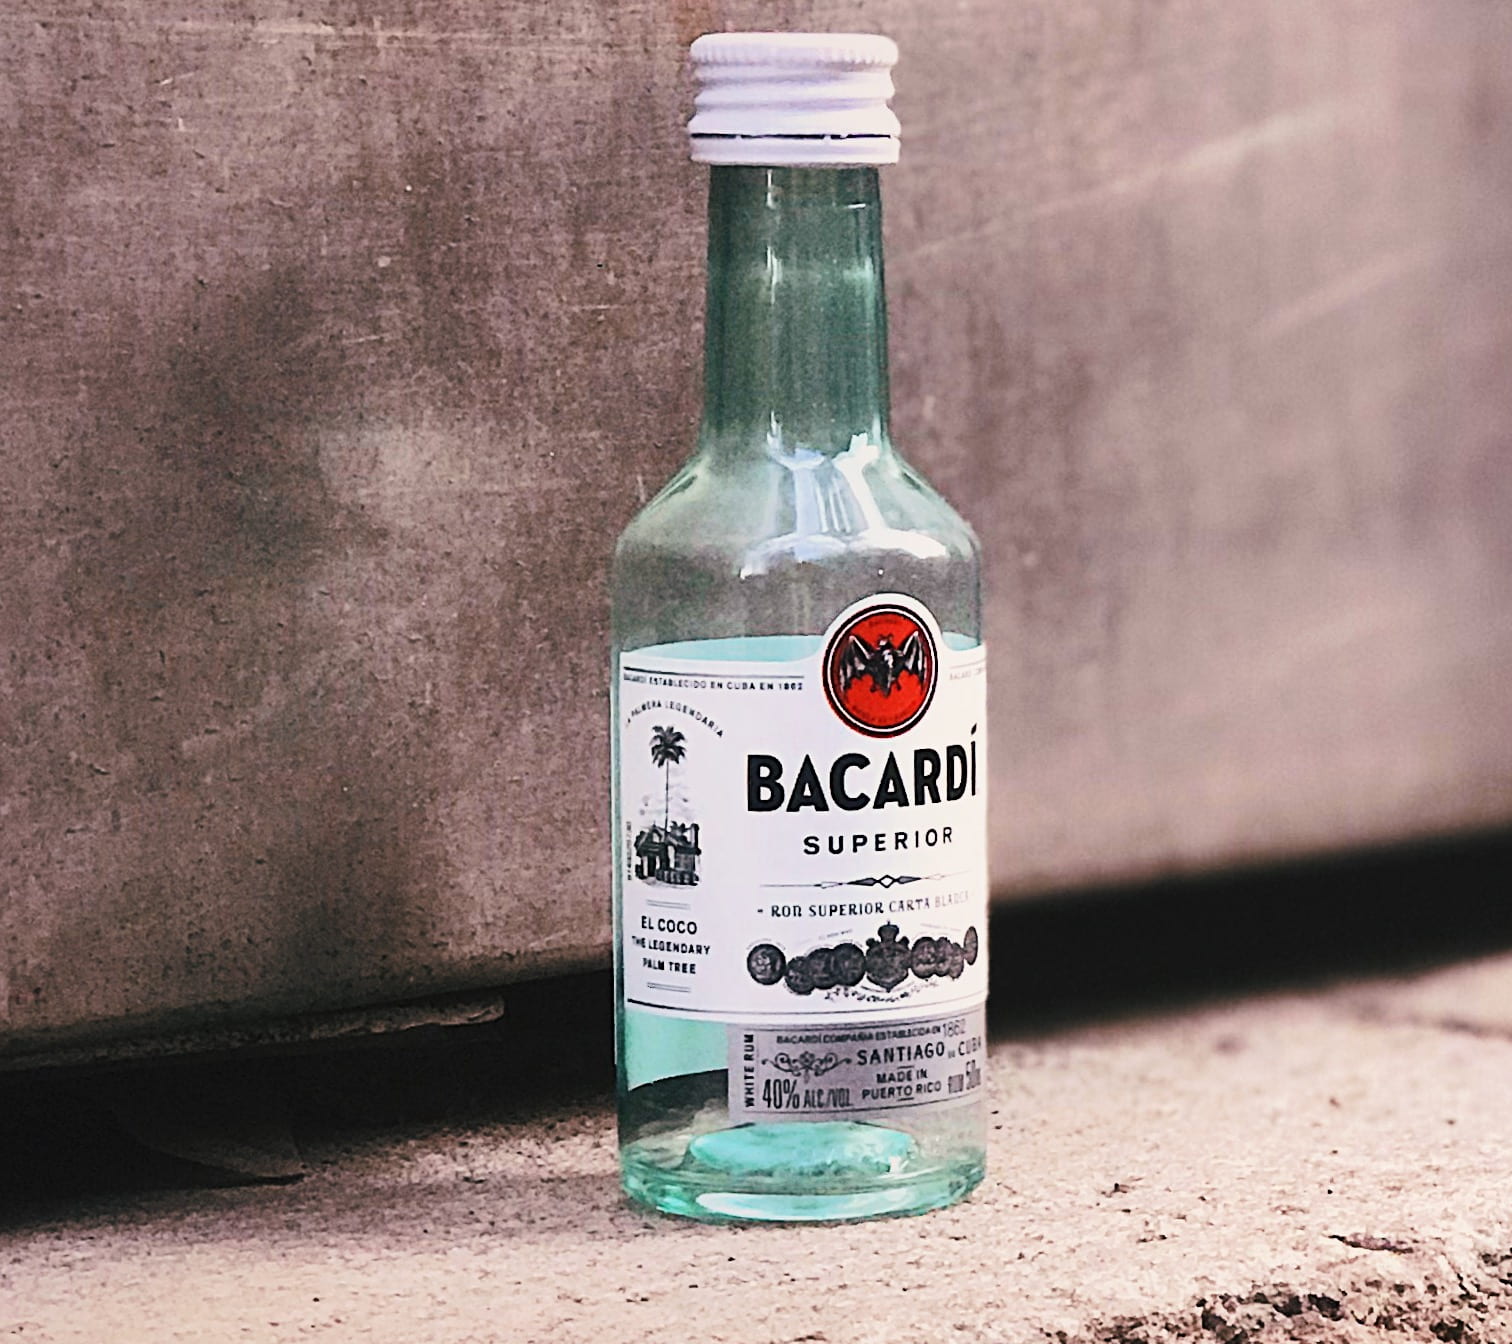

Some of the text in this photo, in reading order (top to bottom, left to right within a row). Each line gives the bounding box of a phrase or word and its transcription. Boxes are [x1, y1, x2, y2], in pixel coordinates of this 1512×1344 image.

[710, 680, 723, 689] EN
[726, 681, 756, 691] CUBA
[759, 682, 774, 691] EN
[746, 723, 977, 813] BACARDÍ
[803, 826, 953, 855] SUPERIOR
[770, 904, 802, 918] RON
[808, 901, 885, 918] SUPERIOR
[888, 898, 931, 913] CARTA
[641, 915, 698, 935] EL COCO
[631, 935, 711, 955] THE LEGENDARY
[642, 957, 697, 974] PALM TREE
[856, 1041, 945, 1065] SANTIAGO
[743, 1034, 755, 1108] WHITE RUM
[876, 1068, 928, 1084] MADE IN
[762, 1078, 801, 1109] 40%
[861, 1080, 942, 1099] PUERTO RICO
